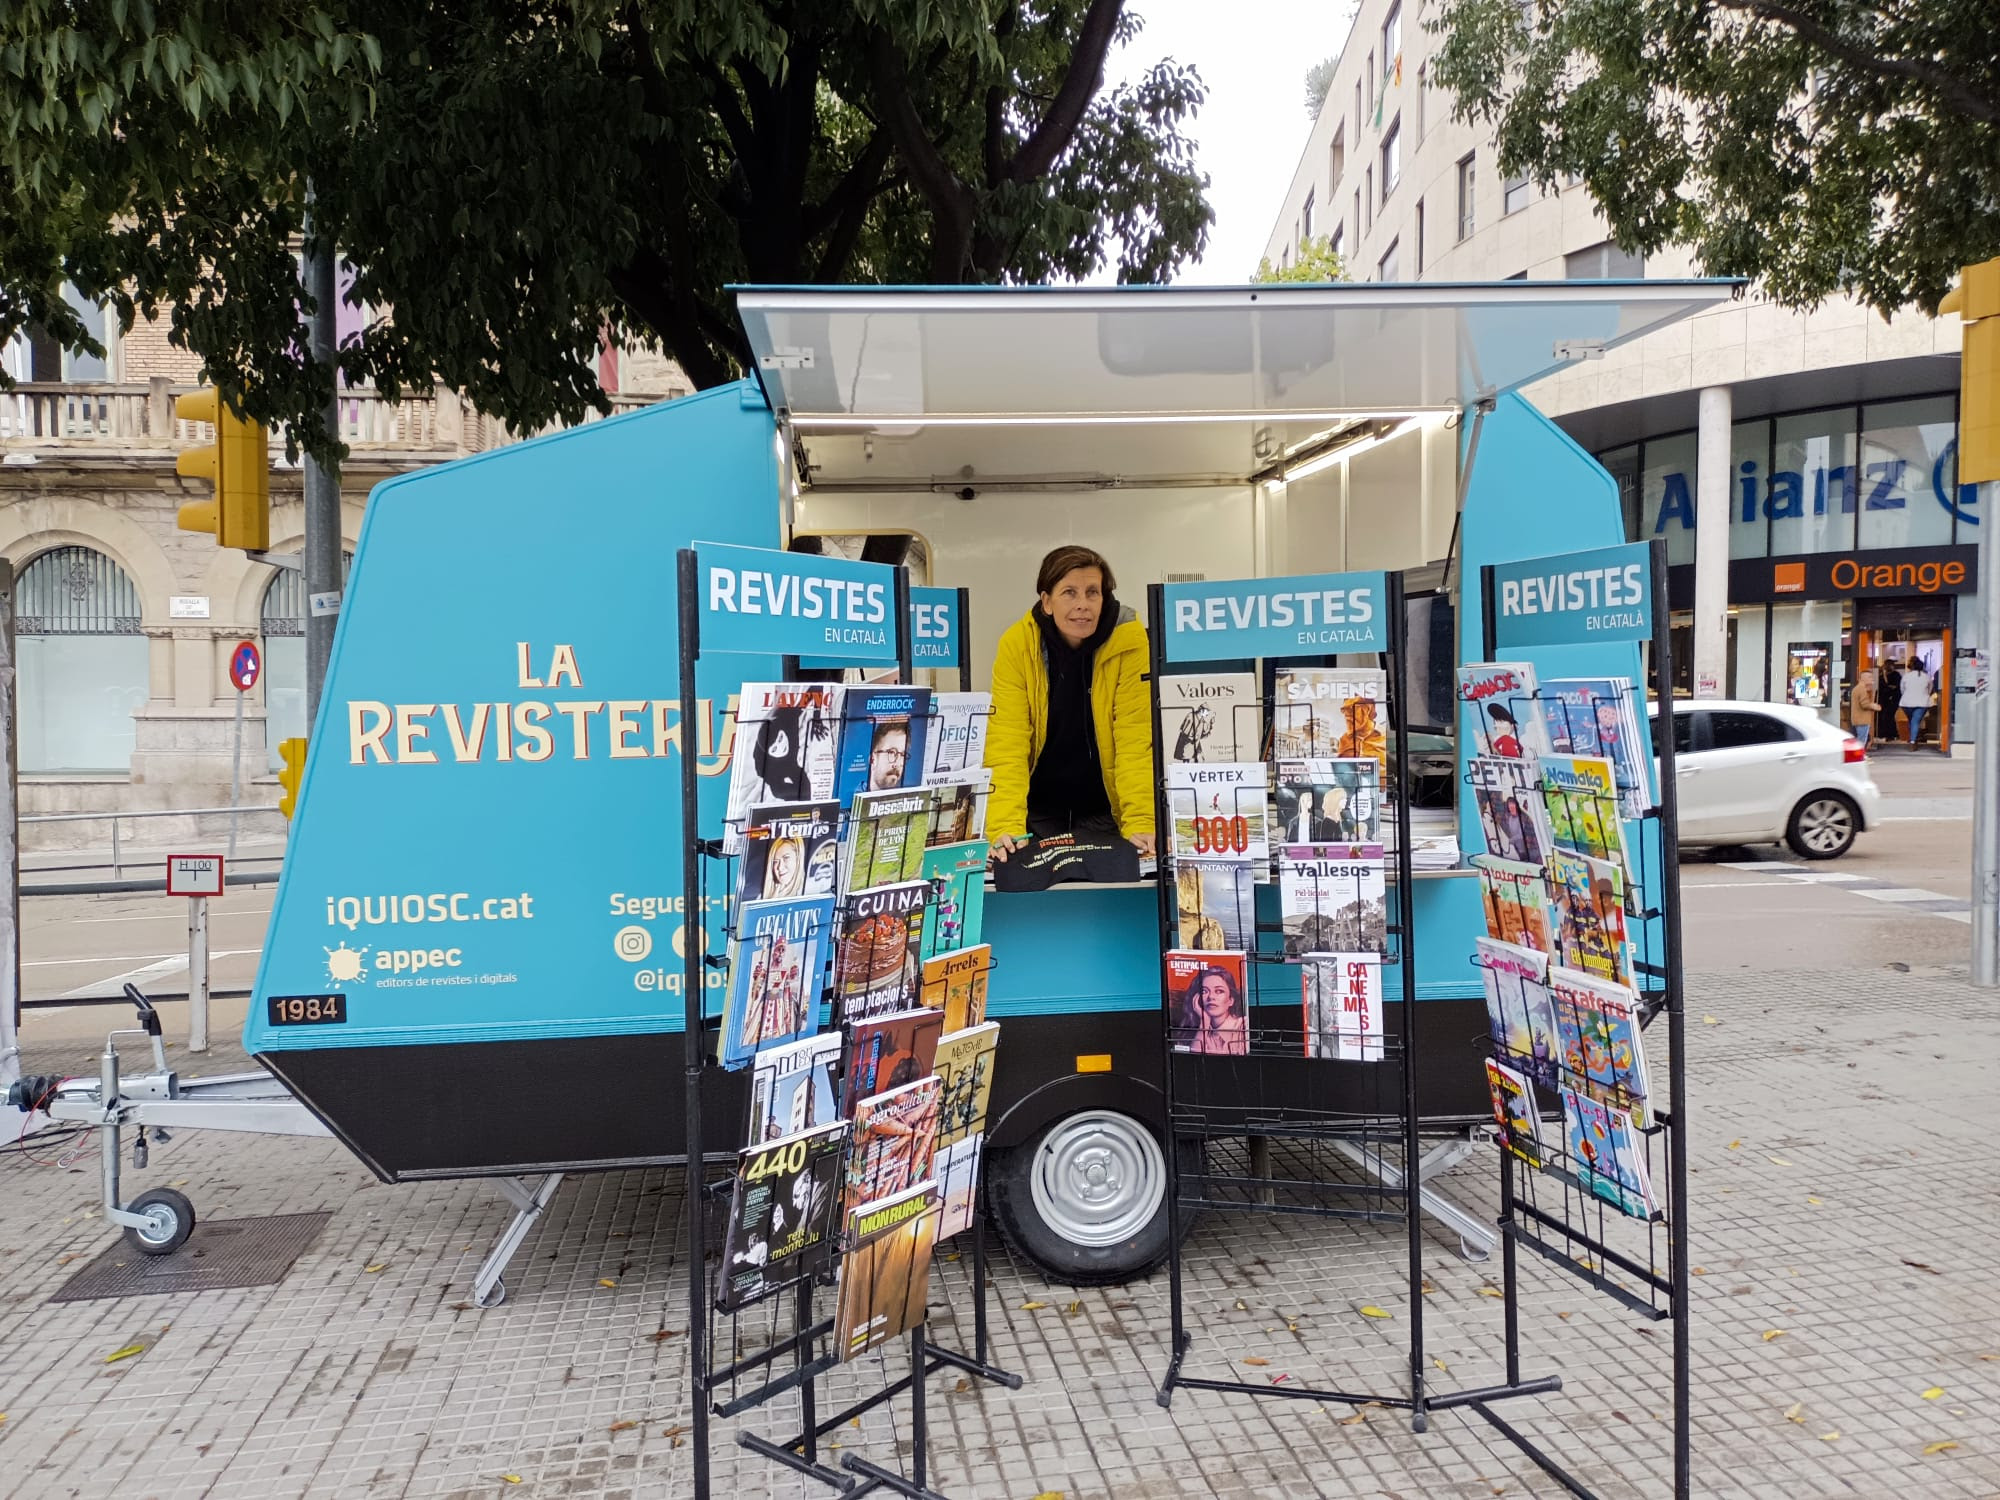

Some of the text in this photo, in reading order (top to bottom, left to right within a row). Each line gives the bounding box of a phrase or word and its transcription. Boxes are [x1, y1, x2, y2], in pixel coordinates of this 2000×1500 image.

[1655, 460, 1907, 533] Aianz
[1831, 559, 1965, 592] Orange
[709, 567, 885, 624] REVISTES
[1502, 564, 1643, 617] REVISTES
[1175, 588, 1373, 633] REVISTES
[1586, 610, 1644, 631] EN CATALÀ
[825, 627, 886, 645] EN CATALÀ
[1298, 627, 1375, 645] EN CATALÀ
[516, 641, 584, 688] LA
[1177, 682, 1235, 699] Valors
[1287, 677, 1379, 700] SÀPIENS
[866, 699, 913, 711] ENDERROCK
[926, 777, 949, 786] VIURE
[1189, 768, 1244, 783] VÈRTEX
[868, 796, 924, 817] Descobrir
[1191, 816, 1249, 855] 300
[179, 859, 212, 870] H 100
[1294, 861, 1371, 877] Vallesos
[326, 893, 534, 931] iQUIOSC.cat
[858, 889, 924, 917] CUINA
[375, 948, 462, 974] appec
[940, 955, 979, 977] Arrels
[376, 977, 413, 988] editors
[415, 976, 429, 987] de
[431, 975, 472, 986] revistes
[480, 972, 518, 986] digitals
[276, 998, 338, 1022] 1984
[889, 1196, 927, 1224] RURAL
